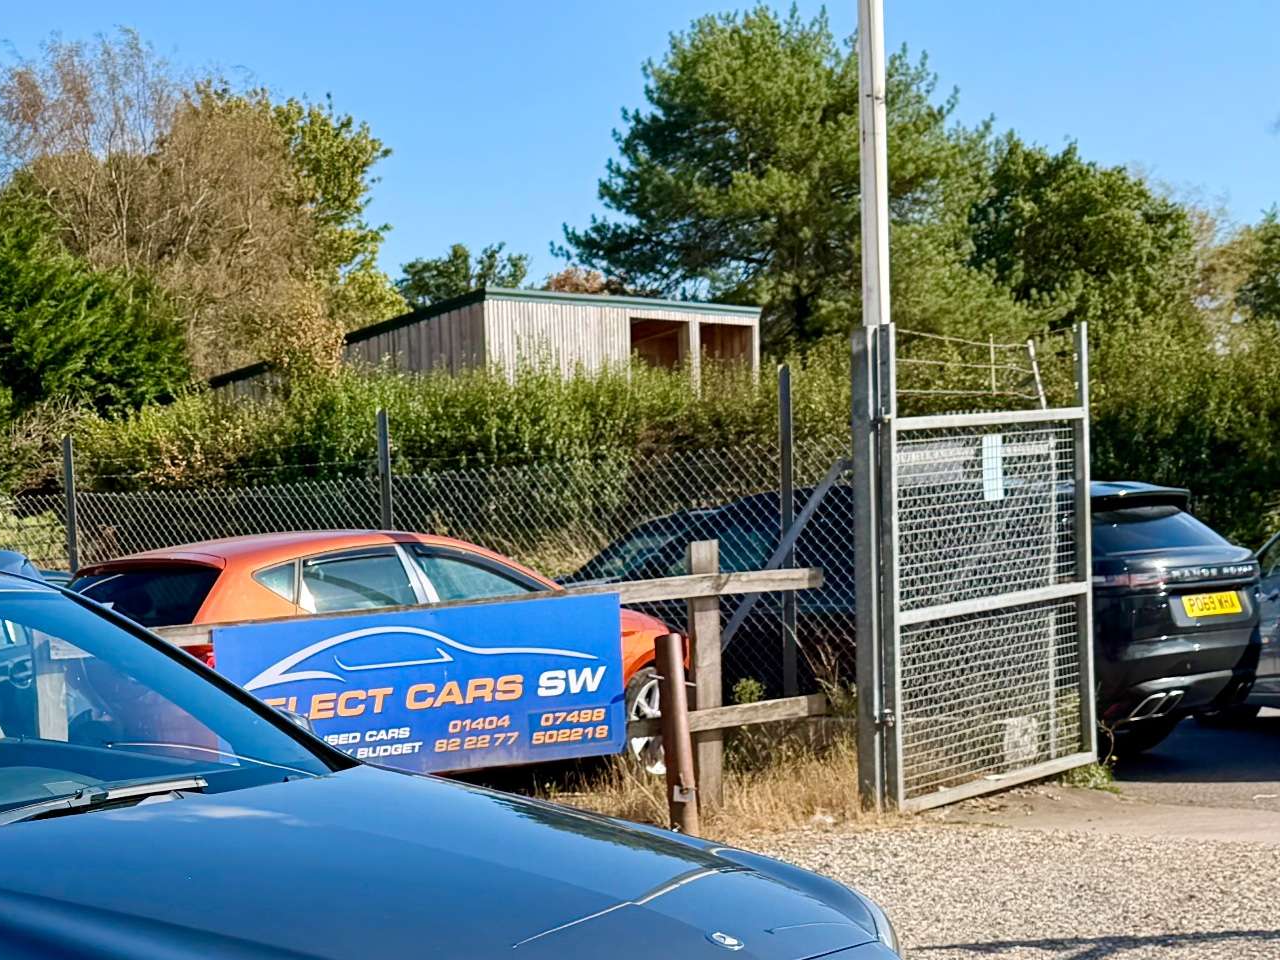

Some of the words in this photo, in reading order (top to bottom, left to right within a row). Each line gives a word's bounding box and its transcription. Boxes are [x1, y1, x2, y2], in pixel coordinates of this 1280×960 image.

[405, 674, 524, 711] CARS
[537, 665, 607, 697] SW
[448, 715, 512, 734] 01404
[323, 732, 362, 746] SED
[364, 727, 411, 743] CARS
[356, 742, 424, 759] BUDGET
